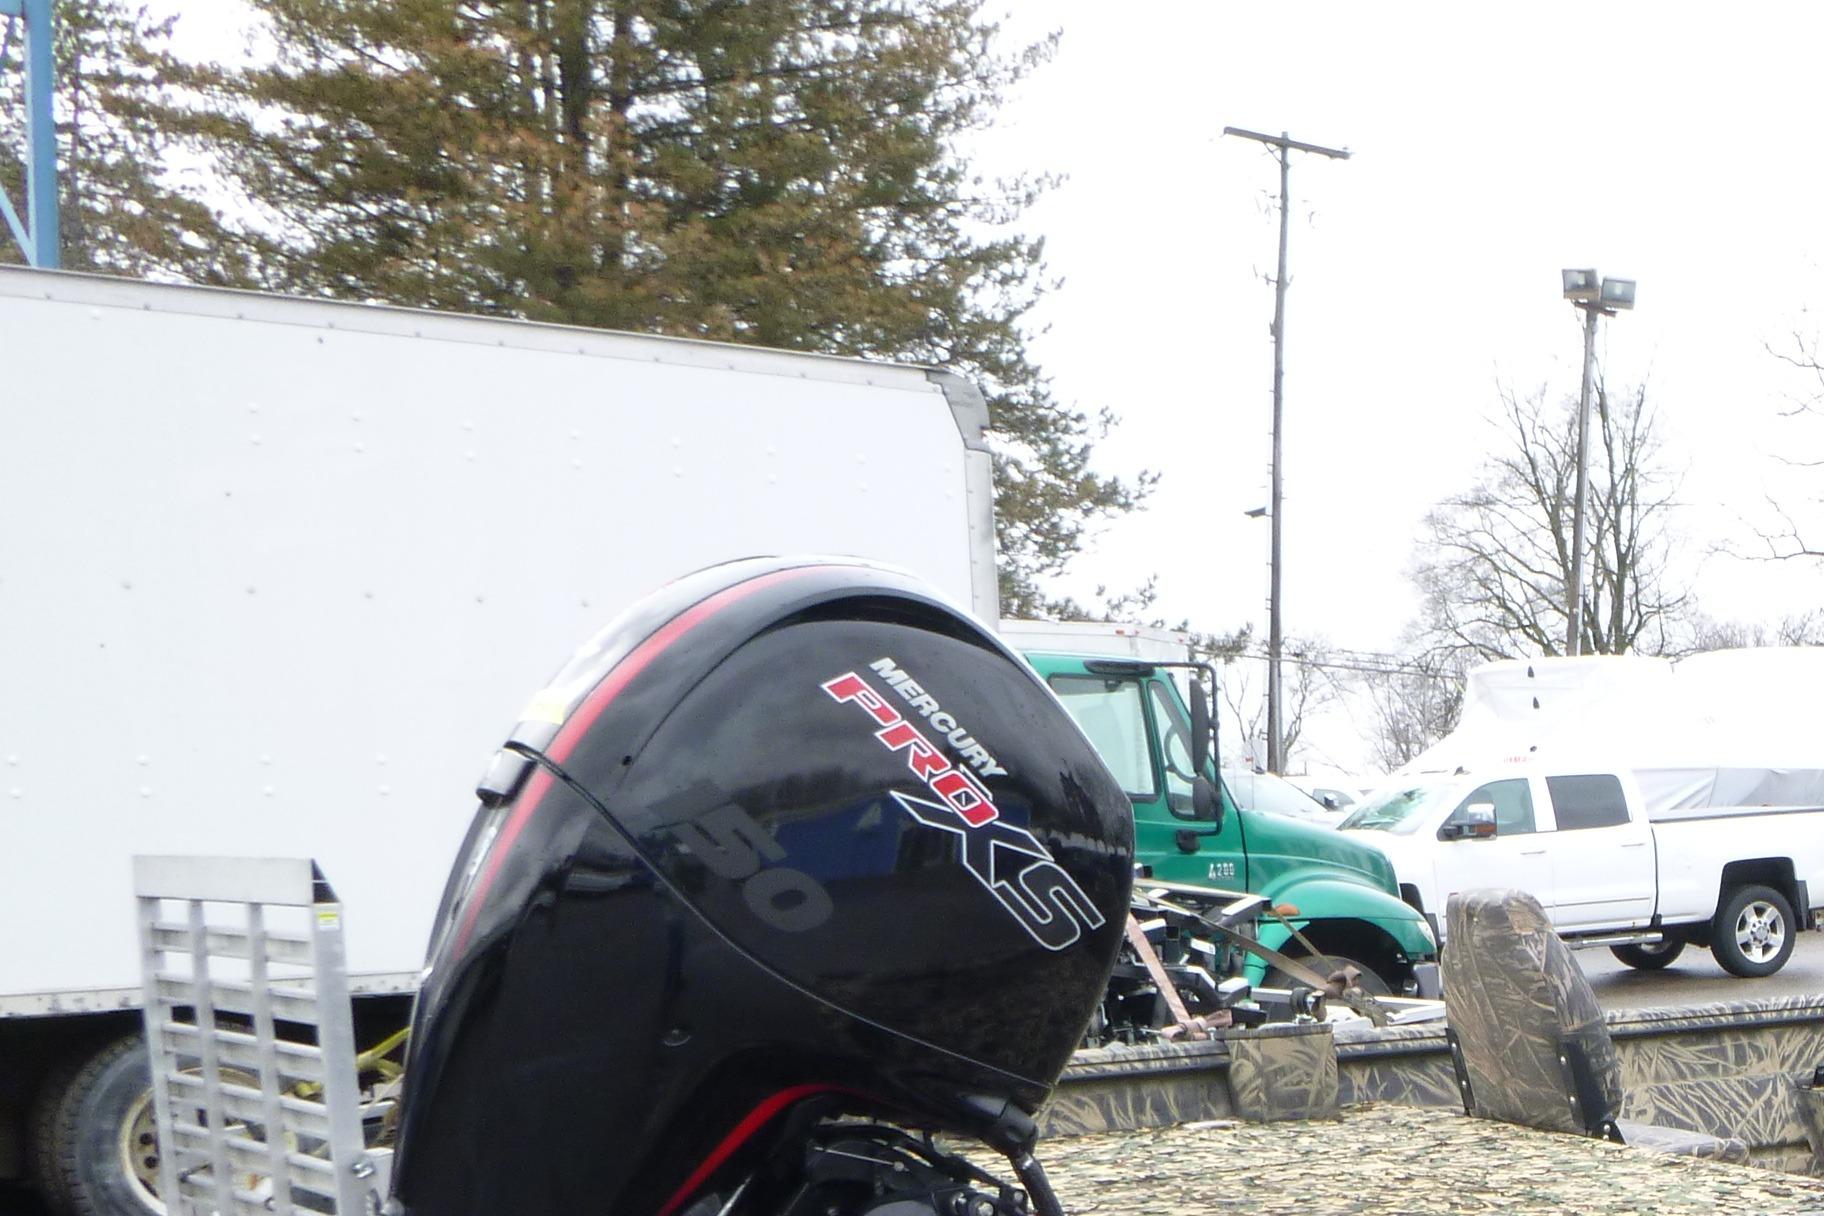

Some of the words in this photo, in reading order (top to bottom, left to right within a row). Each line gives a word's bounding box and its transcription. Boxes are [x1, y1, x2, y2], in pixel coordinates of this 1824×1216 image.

[821, 671, 998, 828] PRO
[869, 657, 1008, 779] MERCURY
[889, 763, 1106, 951] XS
